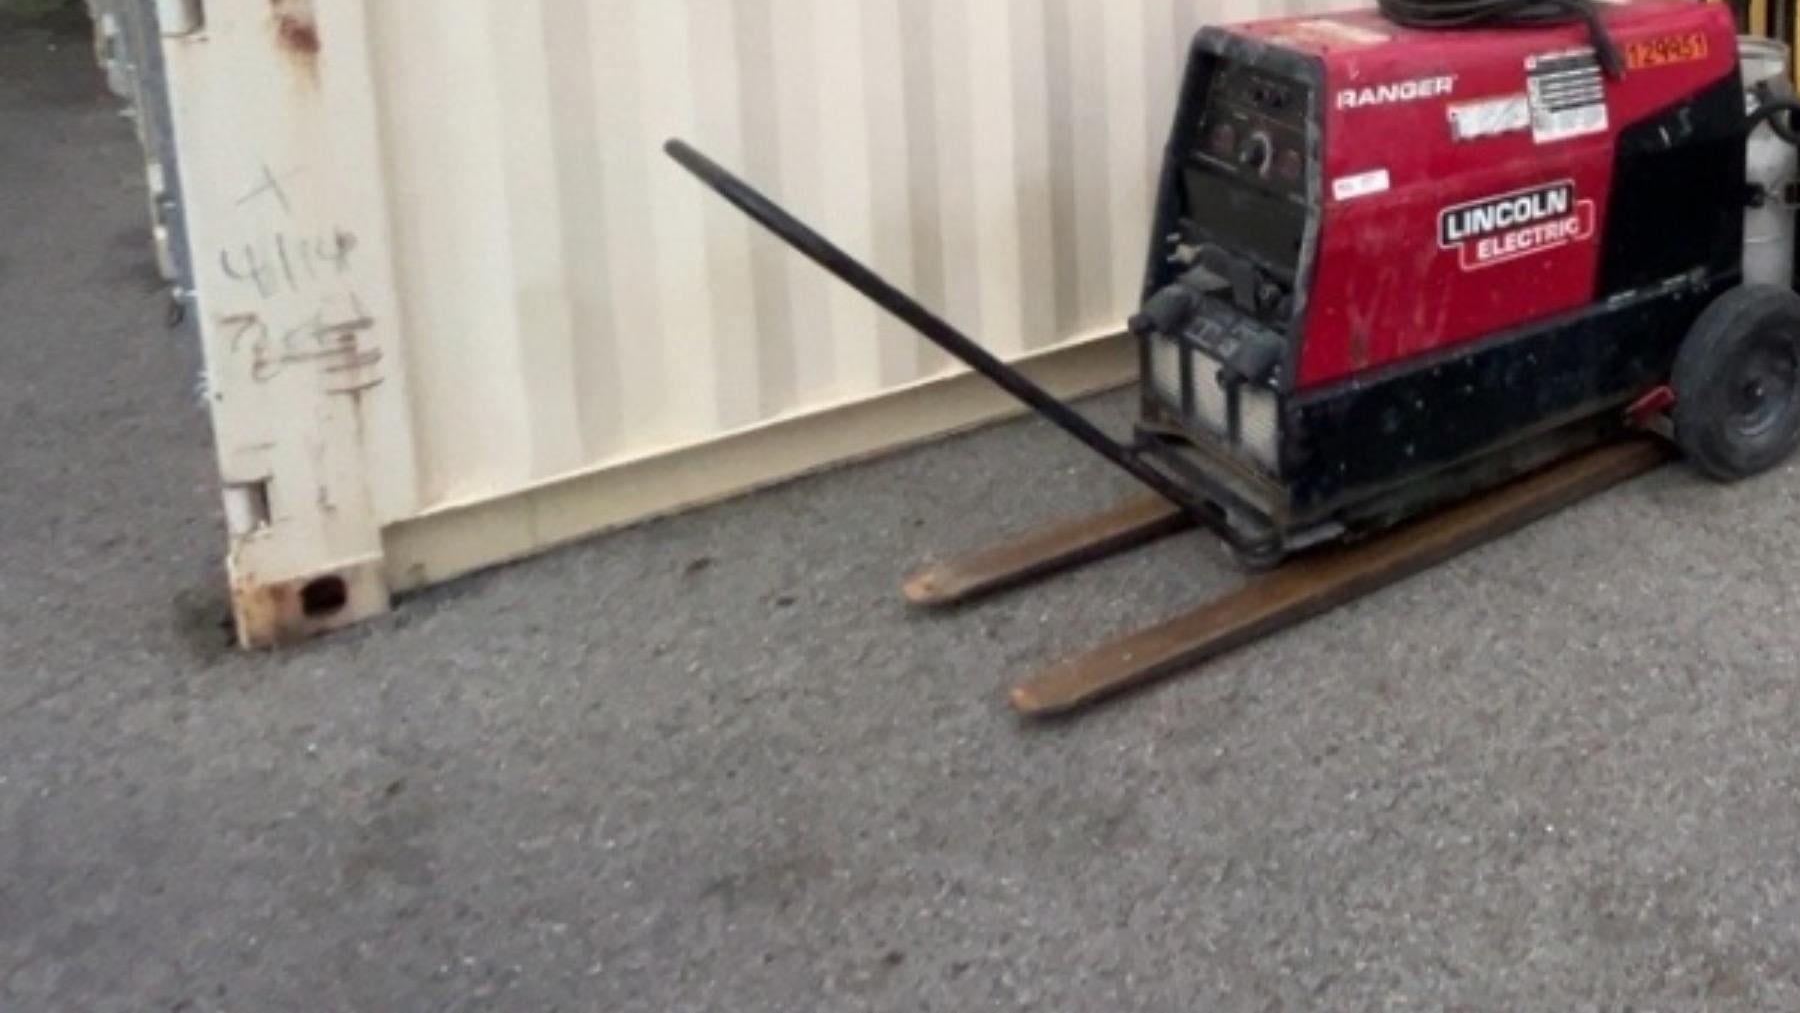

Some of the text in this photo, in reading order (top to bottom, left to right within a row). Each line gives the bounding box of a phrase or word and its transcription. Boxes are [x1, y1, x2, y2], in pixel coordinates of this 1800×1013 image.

[1336, 76, 1453, 111] RANGER
[1448, 187, 1567, 241] LINCOLN
[1477, 217, 1580, 260] ELECTRIC
